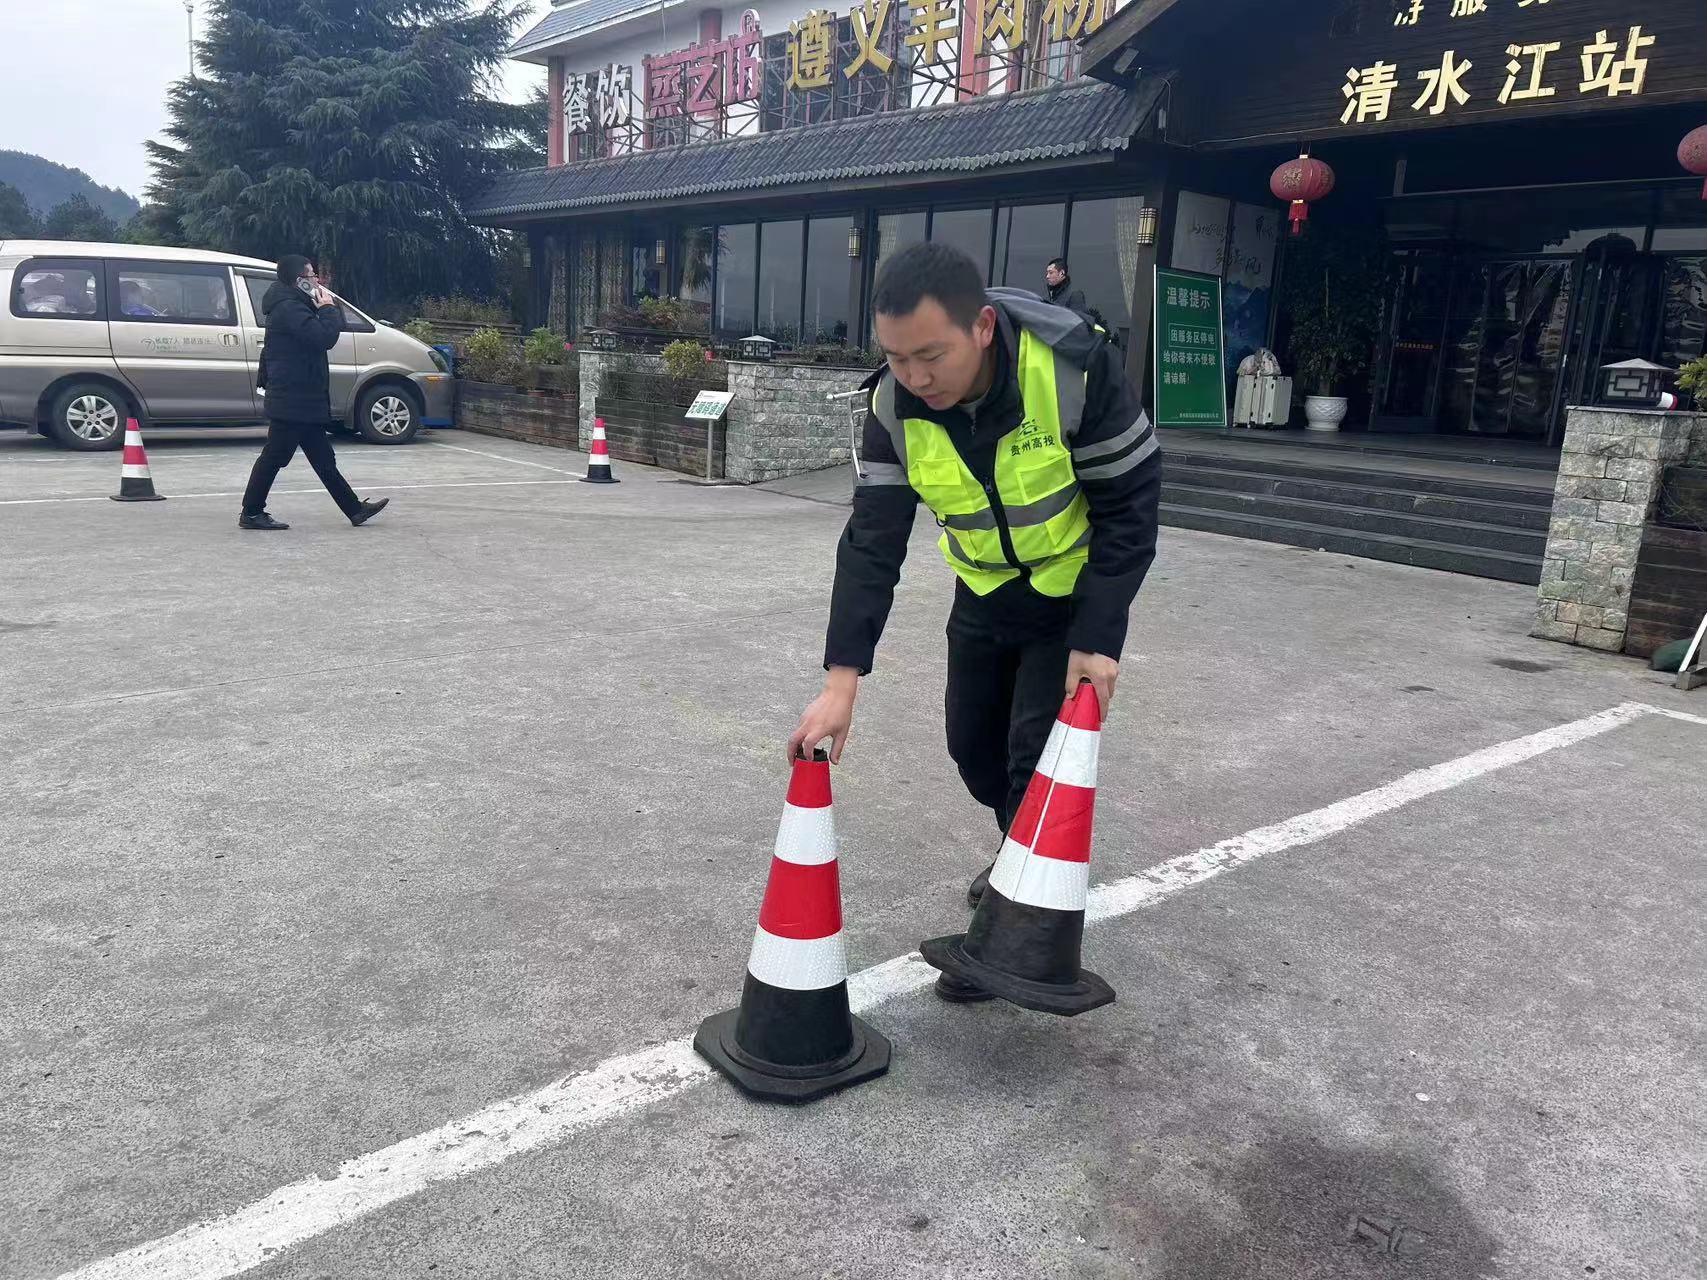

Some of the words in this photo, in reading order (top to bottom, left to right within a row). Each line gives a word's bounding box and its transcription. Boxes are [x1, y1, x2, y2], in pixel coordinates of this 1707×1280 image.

[1340, 25, 1656, 124] 清水江站
[563, 63, 632, 135] 餐饮
[1166, 286, 1211, 309] 温馨提示
[1170, 329, 1215, 345] 因服务区停电
[1010, 434, 1055, 456] 贵州高投
